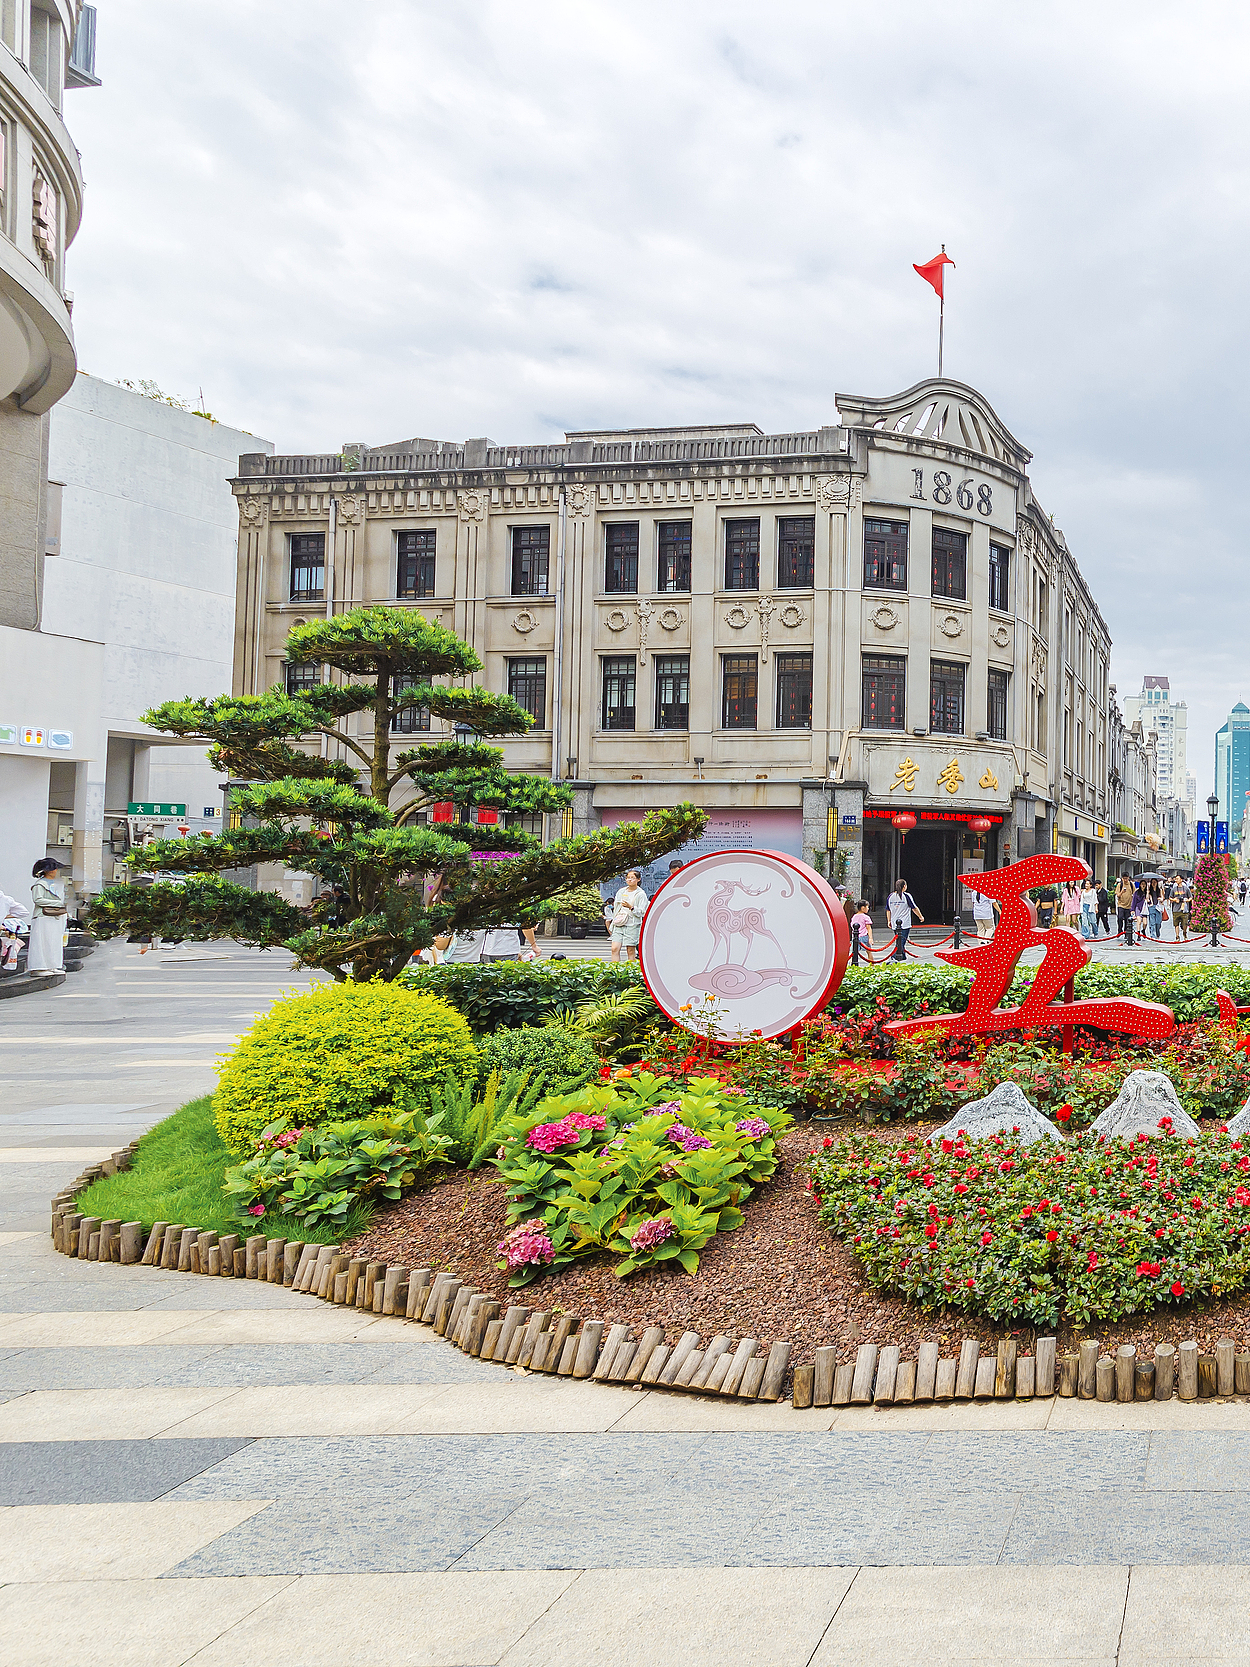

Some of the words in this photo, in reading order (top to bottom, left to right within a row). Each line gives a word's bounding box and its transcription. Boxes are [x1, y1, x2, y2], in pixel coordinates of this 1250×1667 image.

[909, 466, 993, 517] 1868
[890, 756, 999, 794] 老香山
[215, 808, 221, 816] 3
